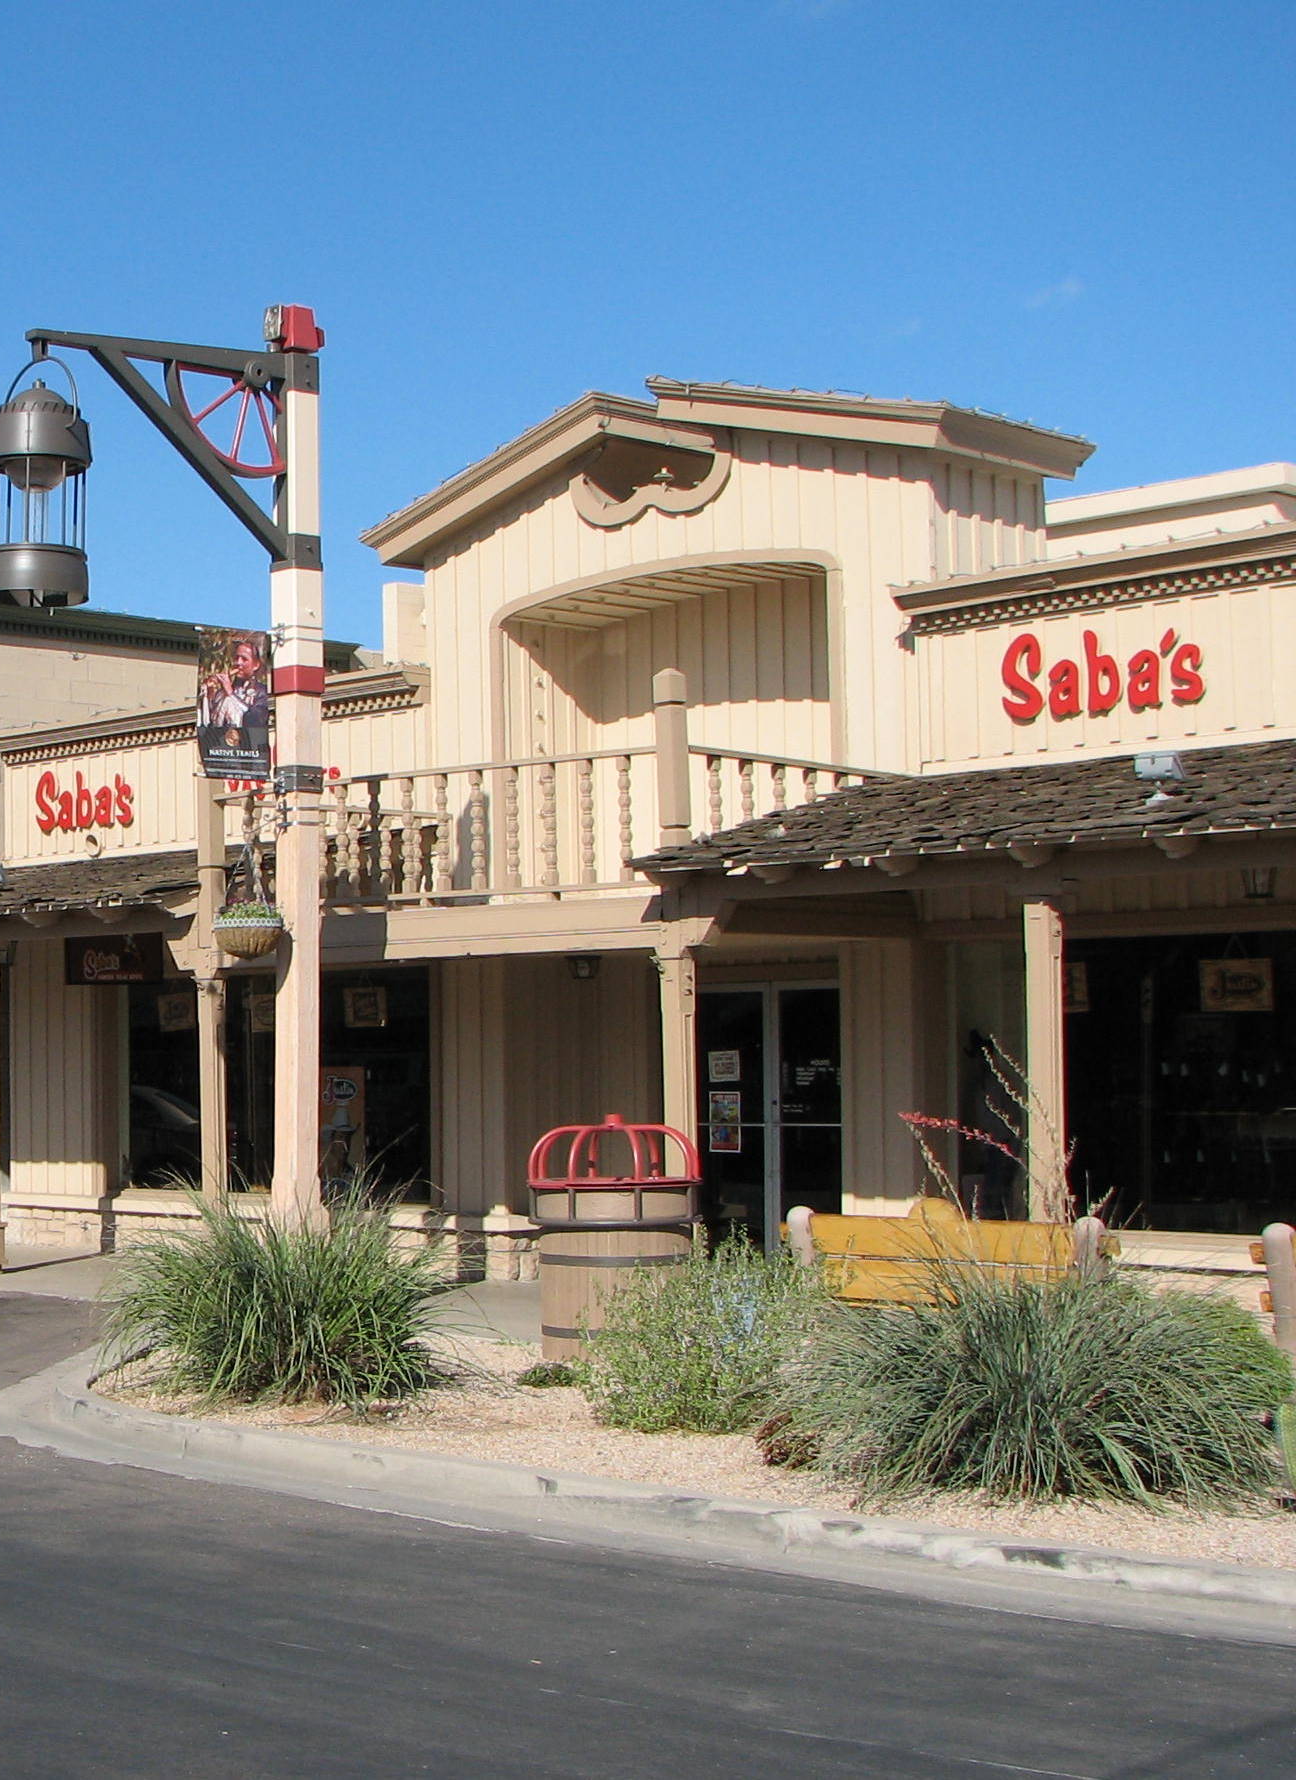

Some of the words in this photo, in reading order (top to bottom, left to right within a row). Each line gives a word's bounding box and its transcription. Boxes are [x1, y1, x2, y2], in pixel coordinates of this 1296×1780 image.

[1002, 628, 1204, 722] Saba's
[209, 748, 234, 757] NATIVE
[236, 749, 260, 758] TRAILS
[36, 771, 134, 835] Saba's
